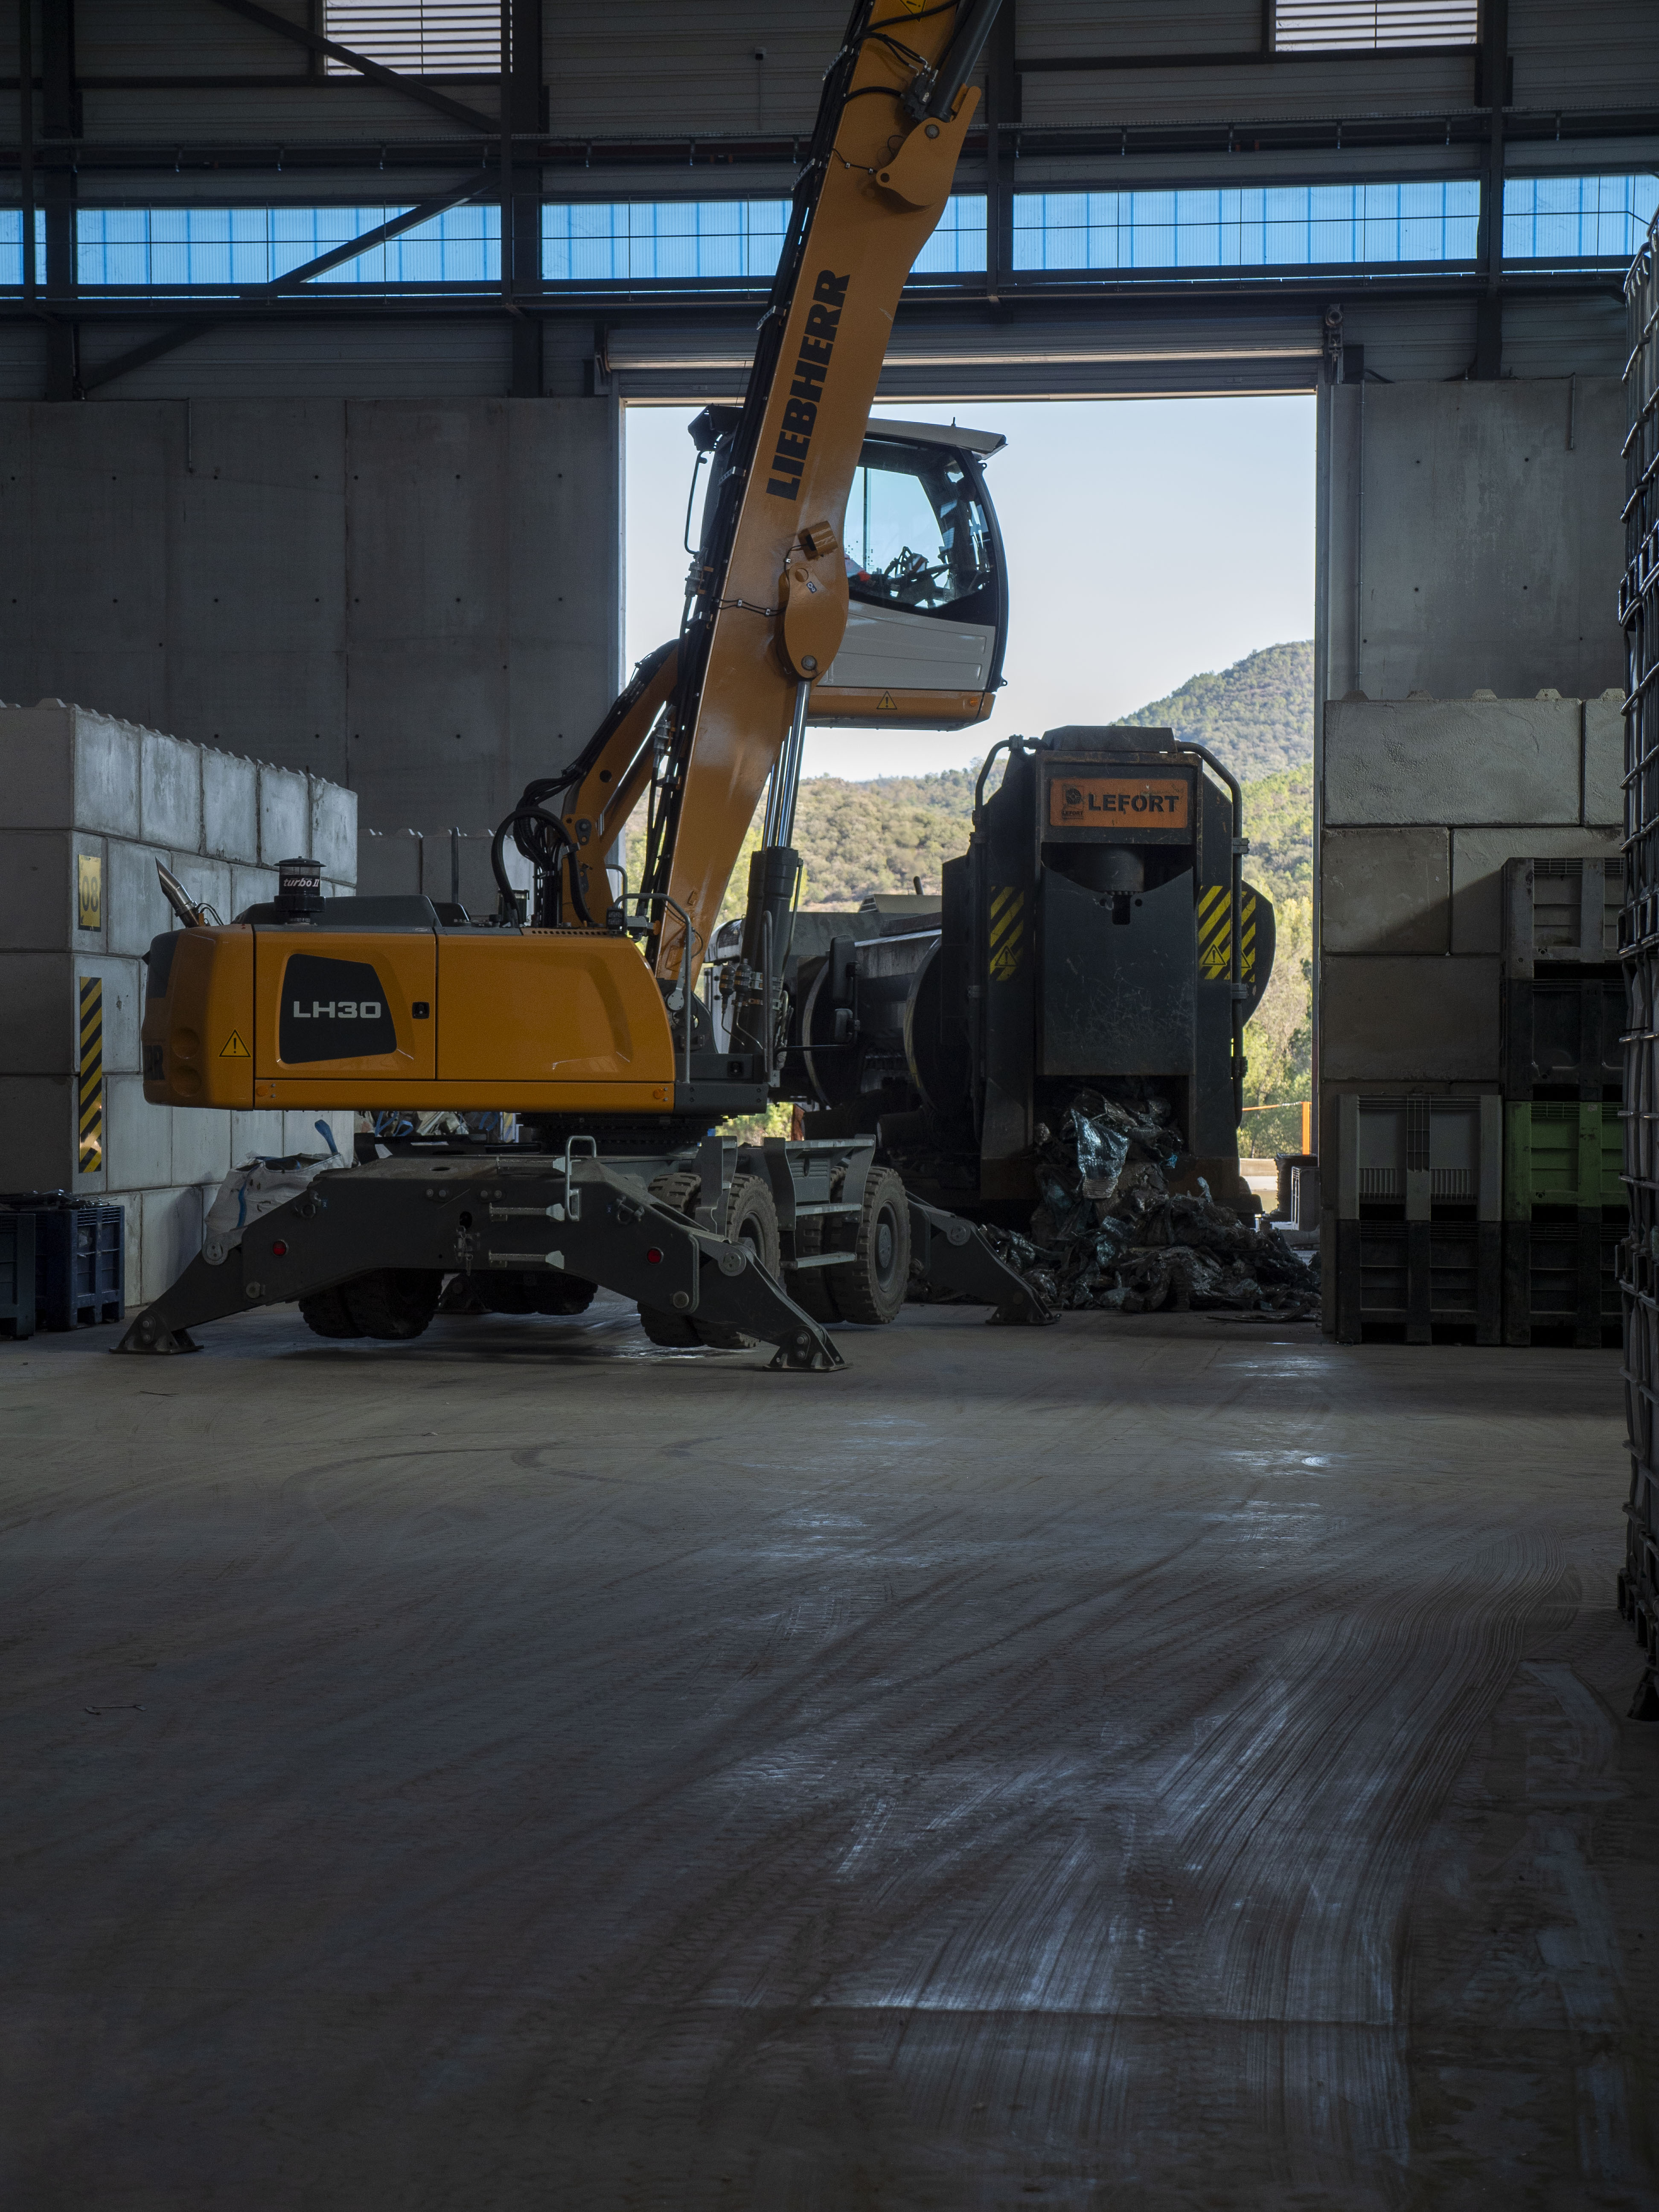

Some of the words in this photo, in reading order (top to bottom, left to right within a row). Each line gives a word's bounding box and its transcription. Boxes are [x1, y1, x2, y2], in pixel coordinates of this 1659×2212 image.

[766, 270, 850, 501] LIEBHERR
[1089, 794, 1179, 812] LEFORT
[283, 878, 312, 887] turbo
[312, 879, 320, 887] II
[82, 876, 99, 912] 08
[294, 1001, 381, 1018] LH30
